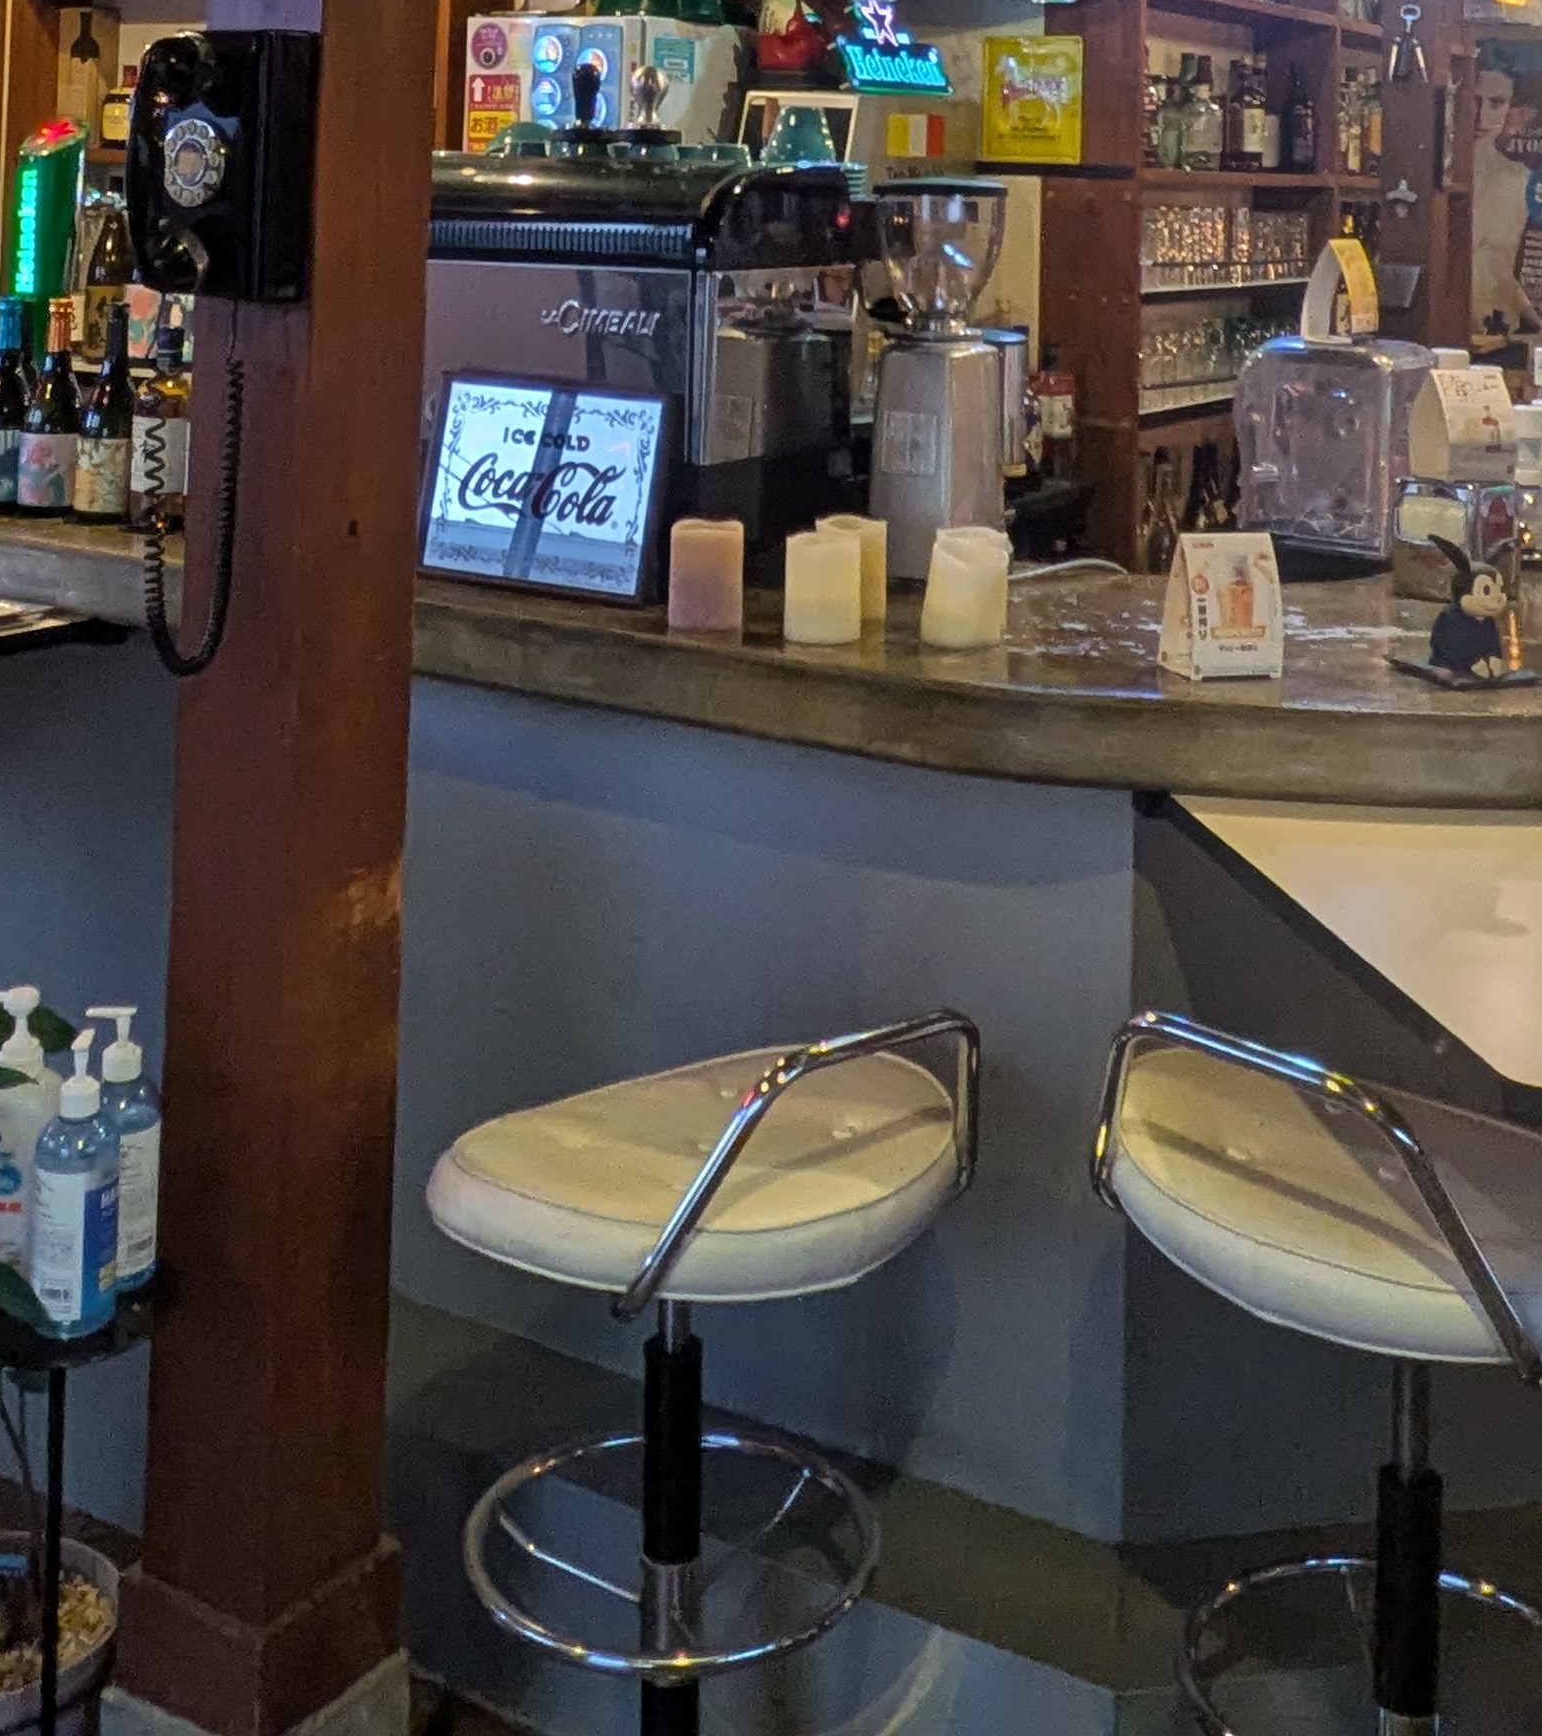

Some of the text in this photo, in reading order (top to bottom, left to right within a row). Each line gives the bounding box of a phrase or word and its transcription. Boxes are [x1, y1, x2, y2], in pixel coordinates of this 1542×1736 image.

[845, 43, 947, 87] Heineken
[14, 168, 38, 294] Heineken
[502, 426, 591, 454] ICE COLD
[457, 452, 628, 528] Coca-Cola
